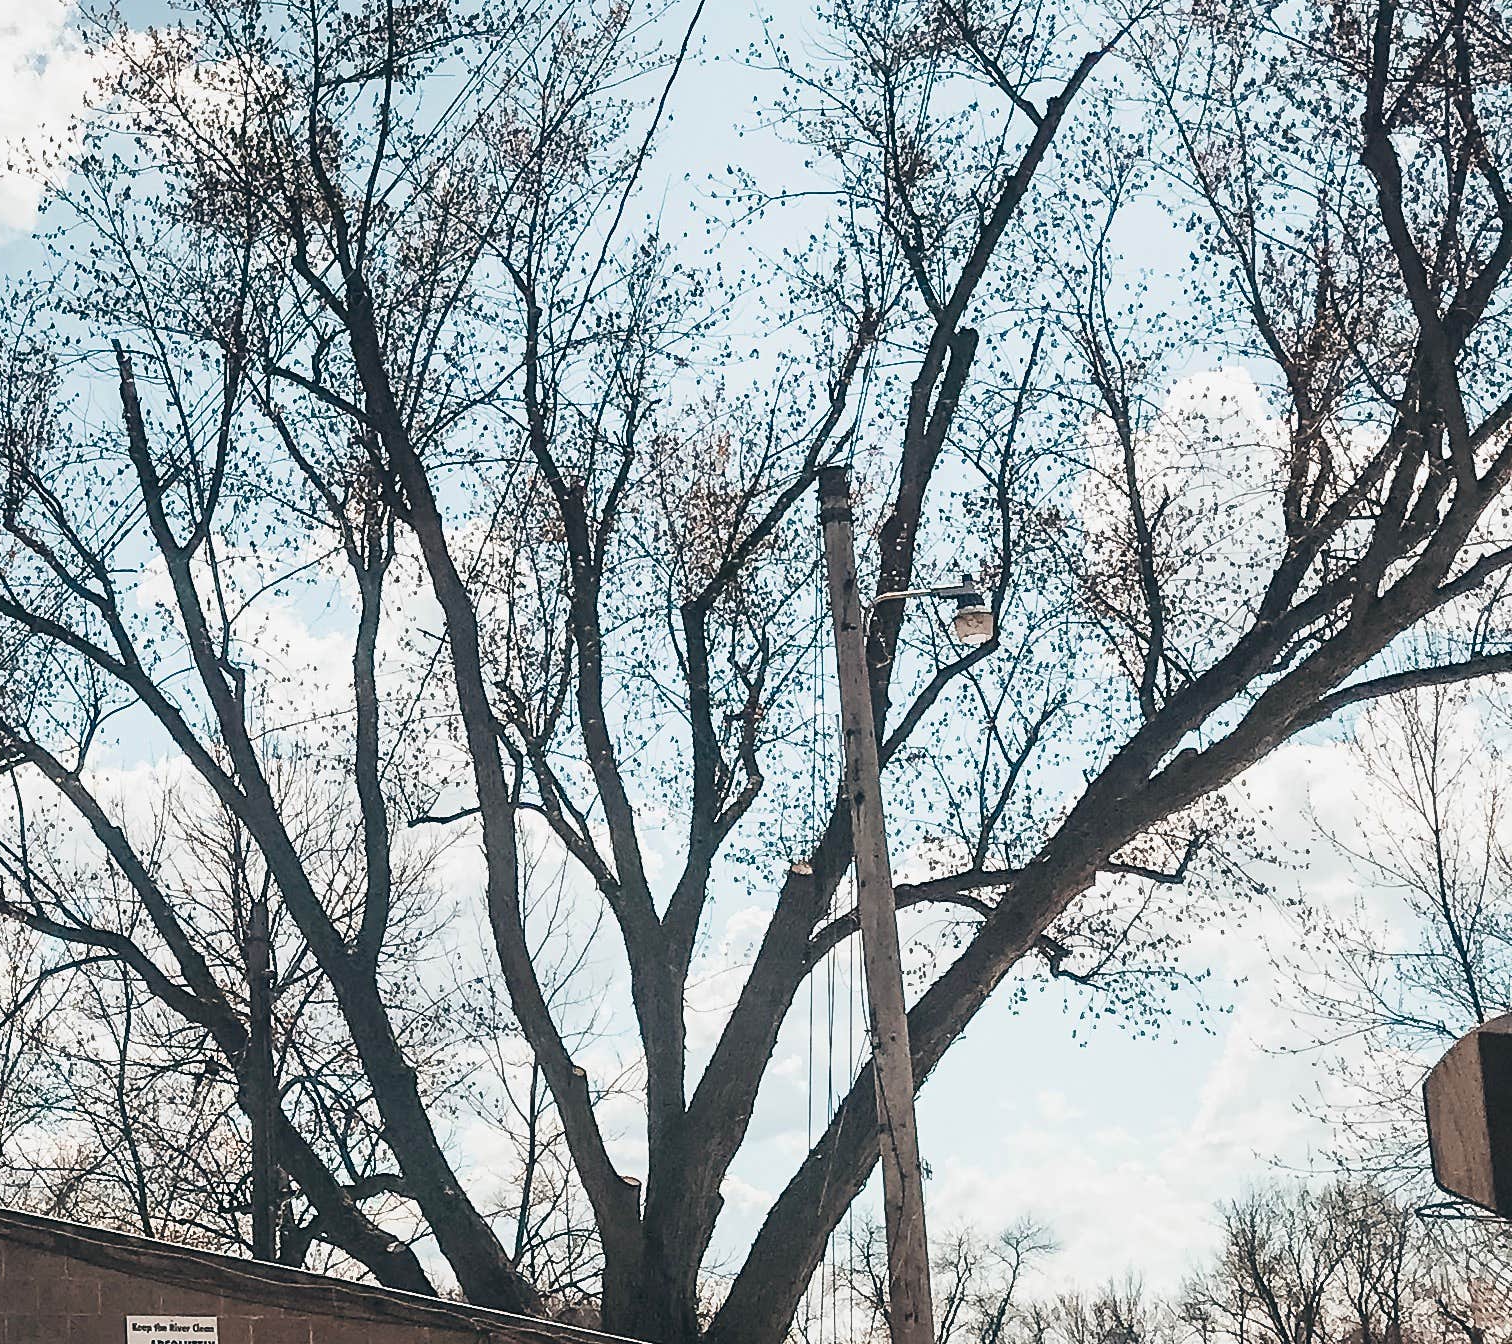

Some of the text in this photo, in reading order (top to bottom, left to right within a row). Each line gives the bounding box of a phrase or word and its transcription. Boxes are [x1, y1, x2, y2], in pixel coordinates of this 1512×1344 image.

[132, 1323, 215, 1333] Keep the River Clean
